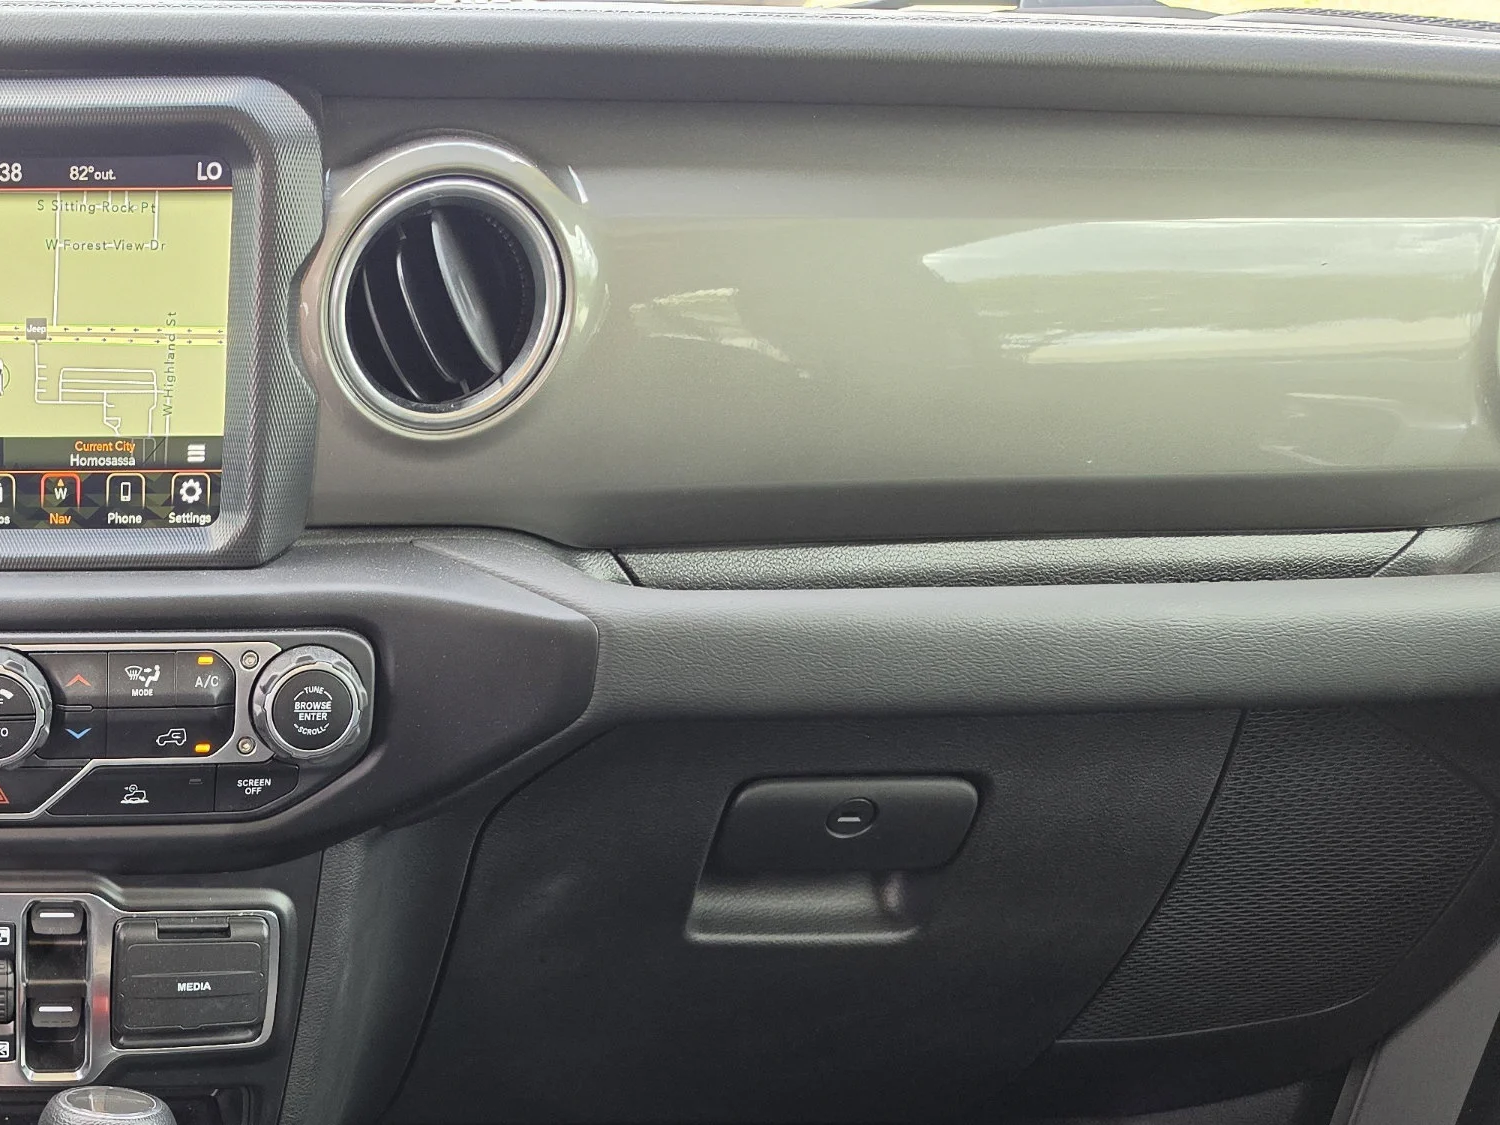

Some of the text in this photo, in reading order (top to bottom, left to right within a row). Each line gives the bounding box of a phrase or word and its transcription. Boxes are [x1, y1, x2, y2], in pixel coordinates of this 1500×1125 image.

[197, 162, 222, 181] LO
[37, 200, 156, 214] S Sitting Rock Pt
[45, 238, 166, 251] W Forest View Dr
[26, 324, 47, 334] Jeep
[163, 311, 176, 416] W Highland St
[74, 440, 136, 454] Current City
[70, 454, 136, 467] Homosassa
[49, 513, 71, 524] Nav
[107, 512, 143, 524] Phone
[168, 512, 212, 527] Settings
[194, 675, 219, 688] A/C
[131, 688, 153, 696] MODE
[304, 685, 325, 694] TUNE
[294, 701, 332, 710] BROWSE
[298, 712, 328, 721] ENTER
[297, 725, 326, 736] SCROLL
[237, 778, 272, 787] SCREEN
[244, 786, 262, 795] OFF
[177, 981, 212, 992] MEDIA
